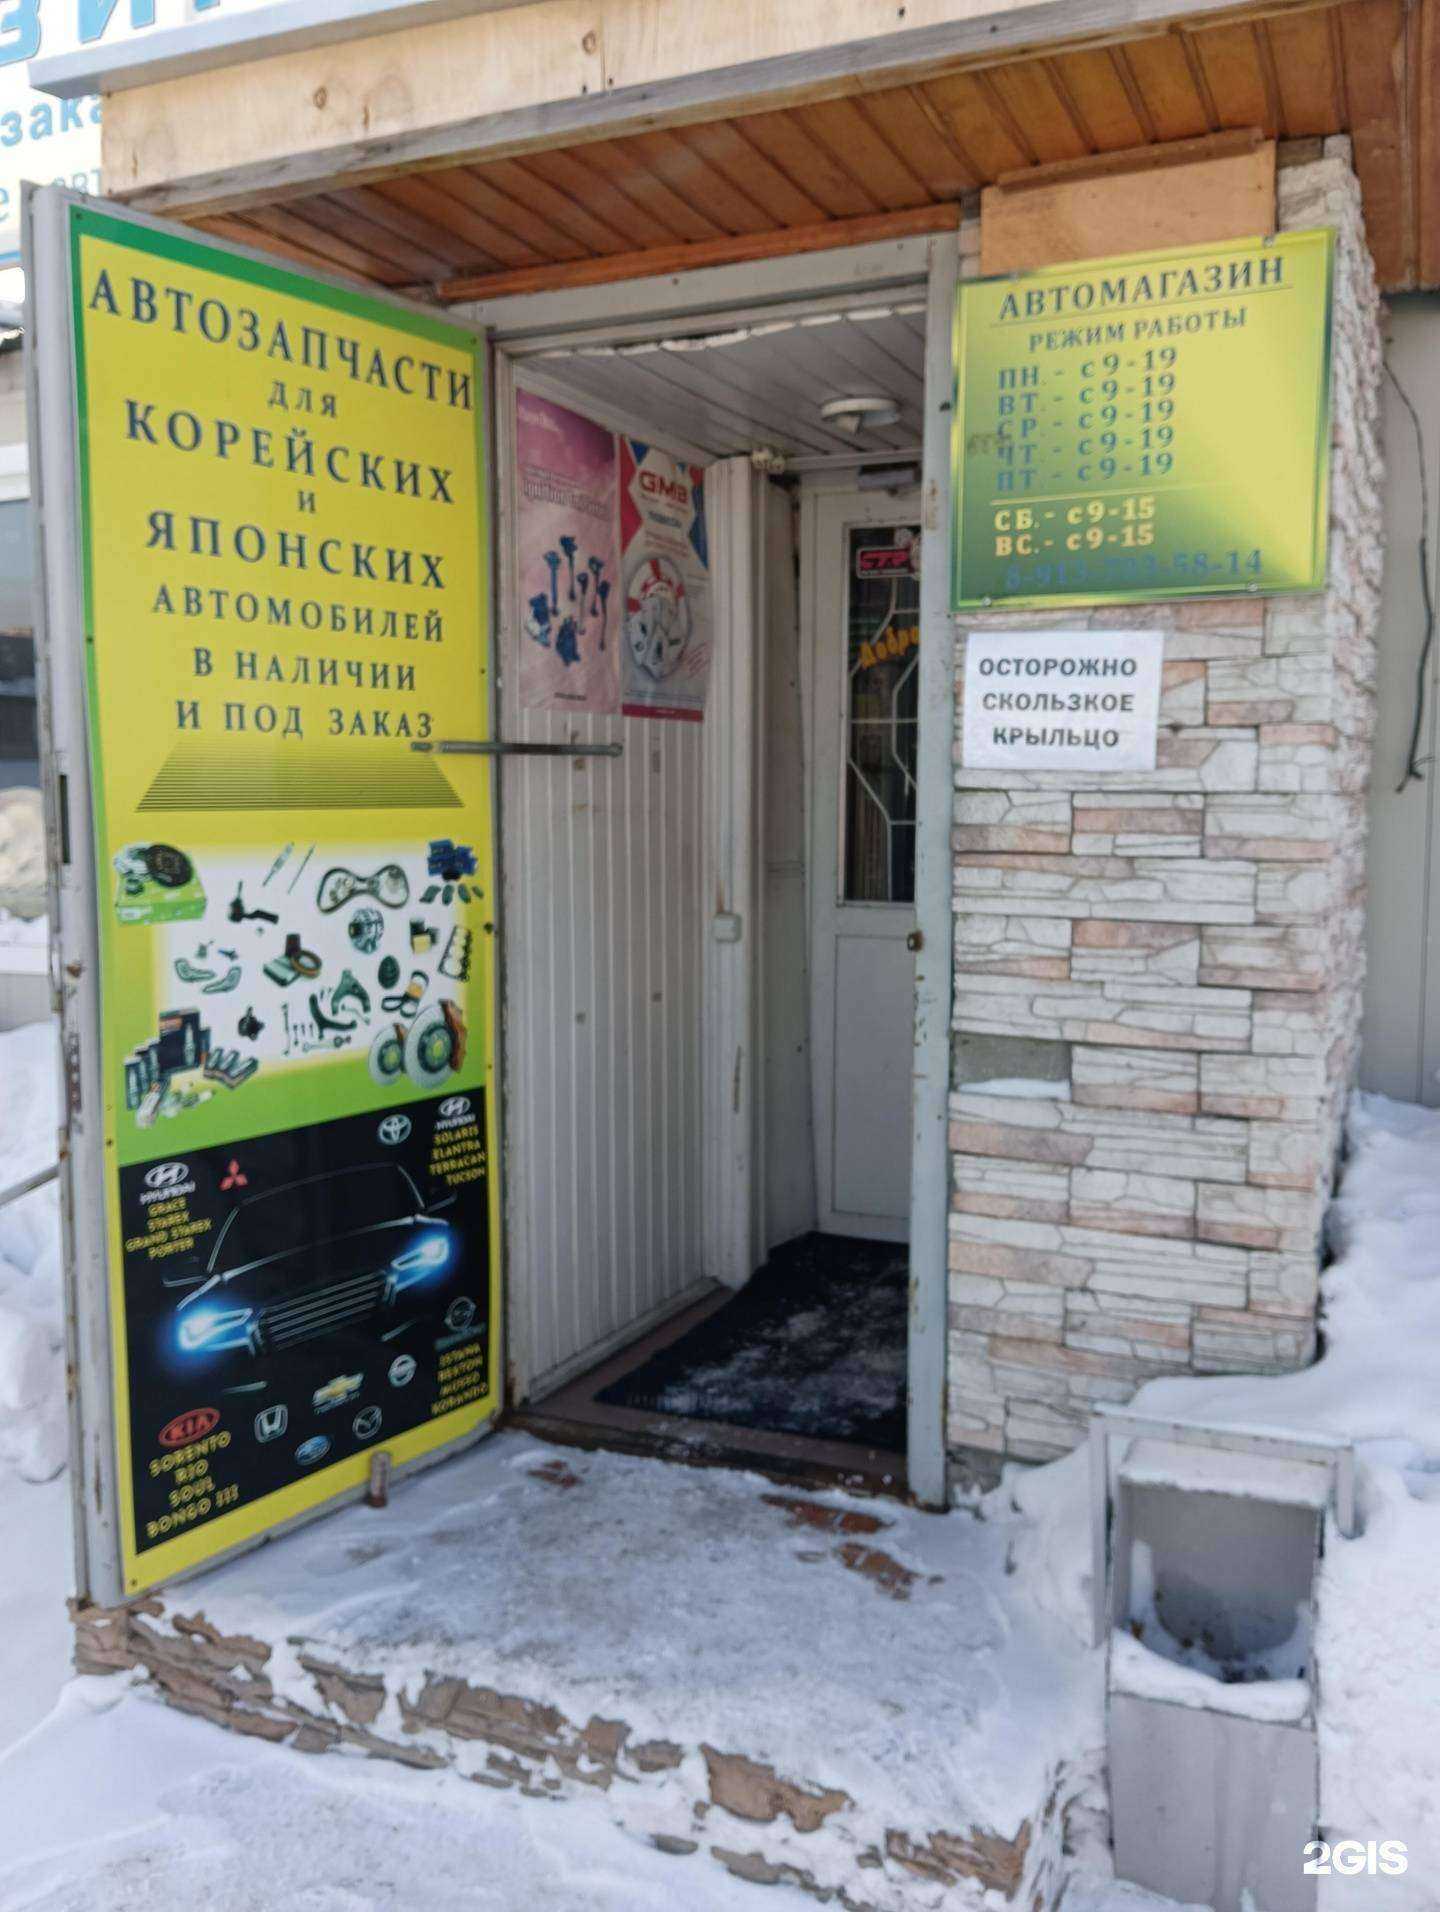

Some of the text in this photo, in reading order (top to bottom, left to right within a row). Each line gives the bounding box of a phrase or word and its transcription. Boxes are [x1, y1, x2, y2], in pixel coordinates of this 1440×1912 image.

[999, 256, 1284, 321] АВТОМАГАЗИН
[89, 267, 474, 410] АВТОЗАПЧАСТИ
[1029, 306, 1248, 353] РЕЖИМ РАБОТЫ
[125, 400, 455, 504] КОРЕЙСКИХ
[639, 469, 688, 505] GMB
[146, 511, 446, 589] ЯПОНСКИХ
[152, 584, 444, 642] АВТОМОБИЛЕЙ
[193, 647, 416, 691] В НАЛИЧИИ
[979, 657, 1137, 677] ОСТОРОЖНО
[176, 699, 433, 740] И ПОД ЗАКАЗ
[982, 692, 1134, 712] СКОЛЬЗКОЕ
[992, 727, 1120, 750] КРЫЛЬЦО
[149, 1430, 231, 1478] SORENTO
